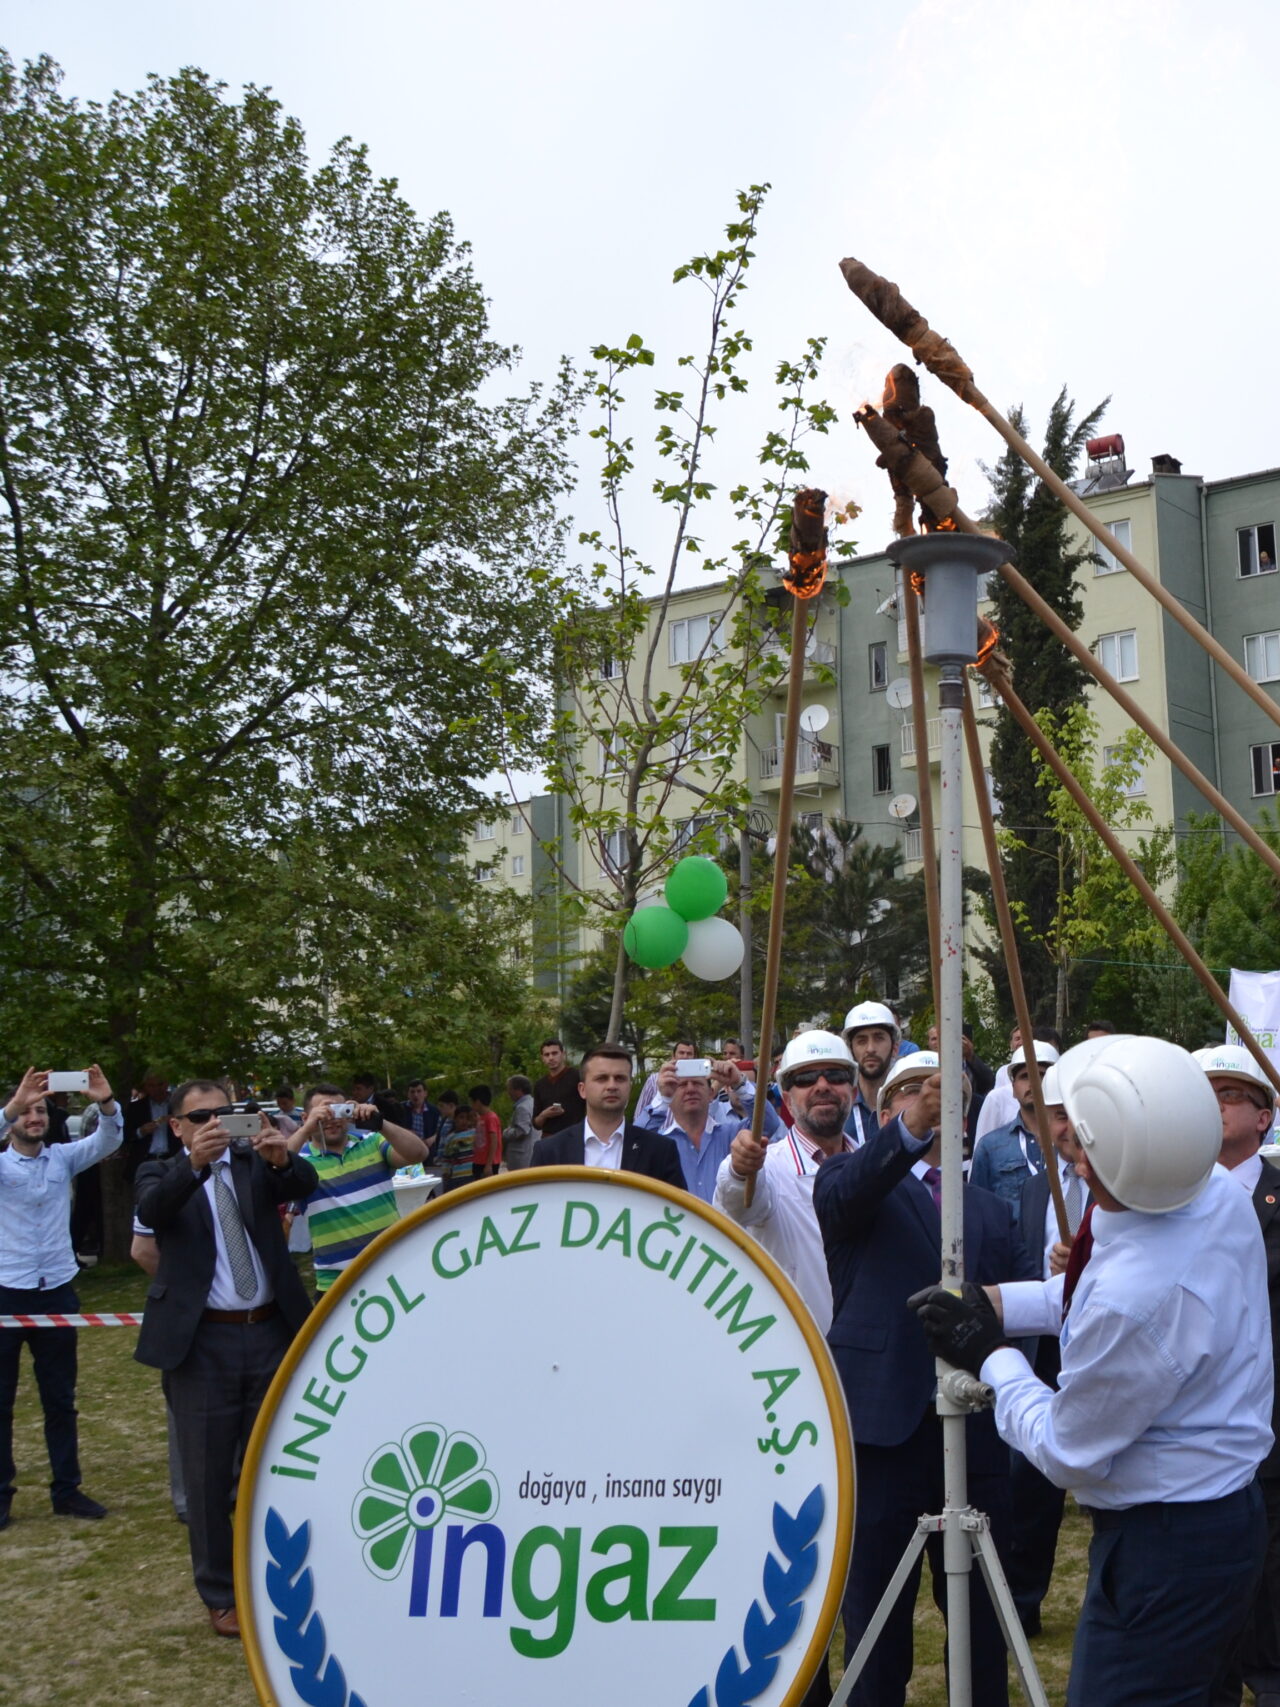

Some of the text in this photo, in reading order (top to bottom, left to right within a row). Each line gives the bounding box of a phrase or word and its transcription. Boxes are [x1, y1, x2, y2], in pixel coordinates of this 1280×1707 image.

[270, 1200, 819, 1482] İNEGÖL GAZ DAĞITIM A.Ş.
[518, 1470, 587, 1506] doğaya
[605, 1472, 666, 1498] insana
[672, 1477, 722, 1504] saygı
[408, 1496, 719, 1659] ingaz
